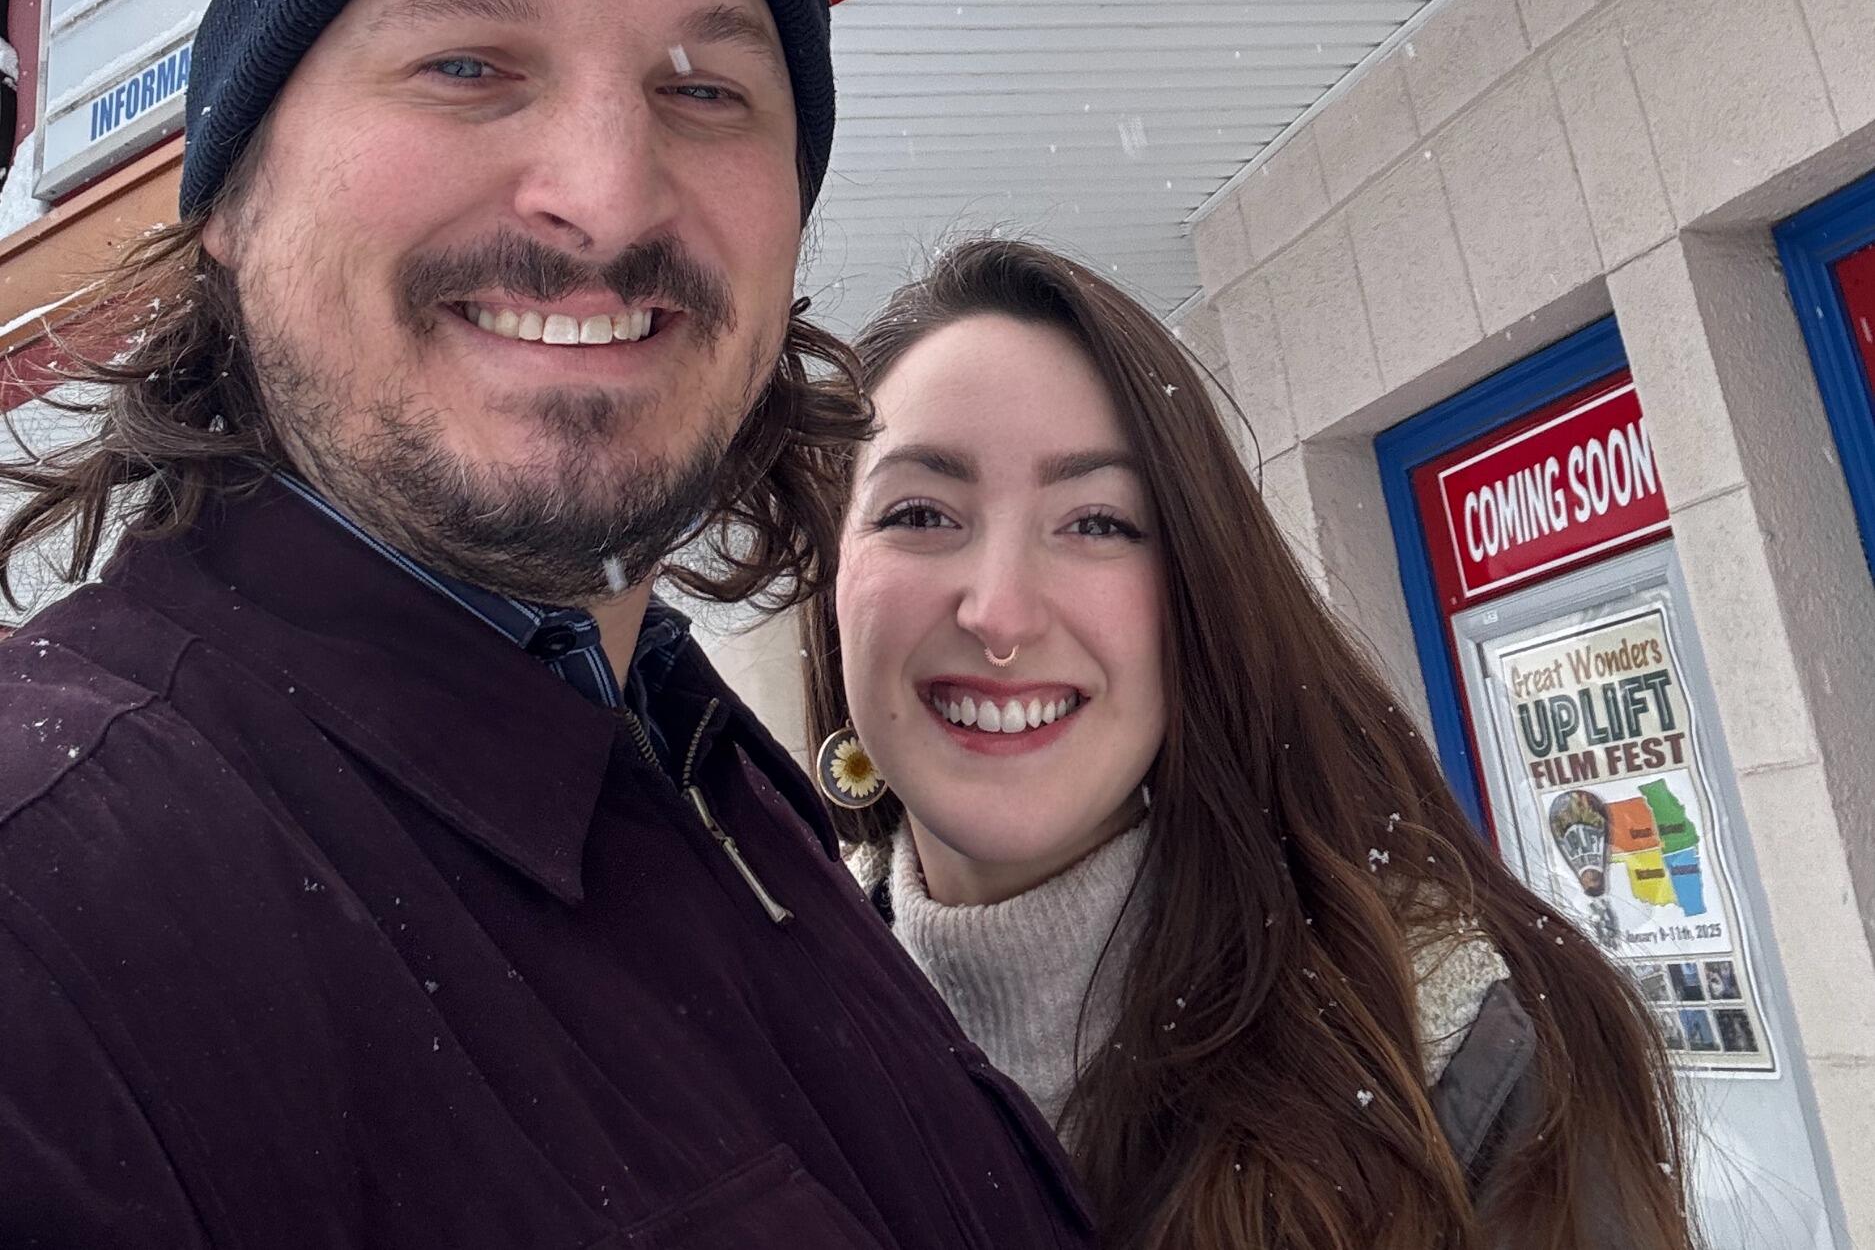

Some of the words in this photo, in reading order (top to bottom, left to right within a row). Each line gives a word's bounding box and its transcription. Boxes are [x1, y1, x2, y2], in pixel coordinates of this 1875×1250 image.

[1464, 456, 1568, 562] COMING
[1568, 418, 1657, 523] SOON
[1511, 659, 1563, 698] Great
[1566, 638, 1663, 685] Wonders
[1518, 668, 1677, 758] UPLIFT
[1530, 750, 1600, 789] FILM
[1604, 732, 1685, 776] FEST
